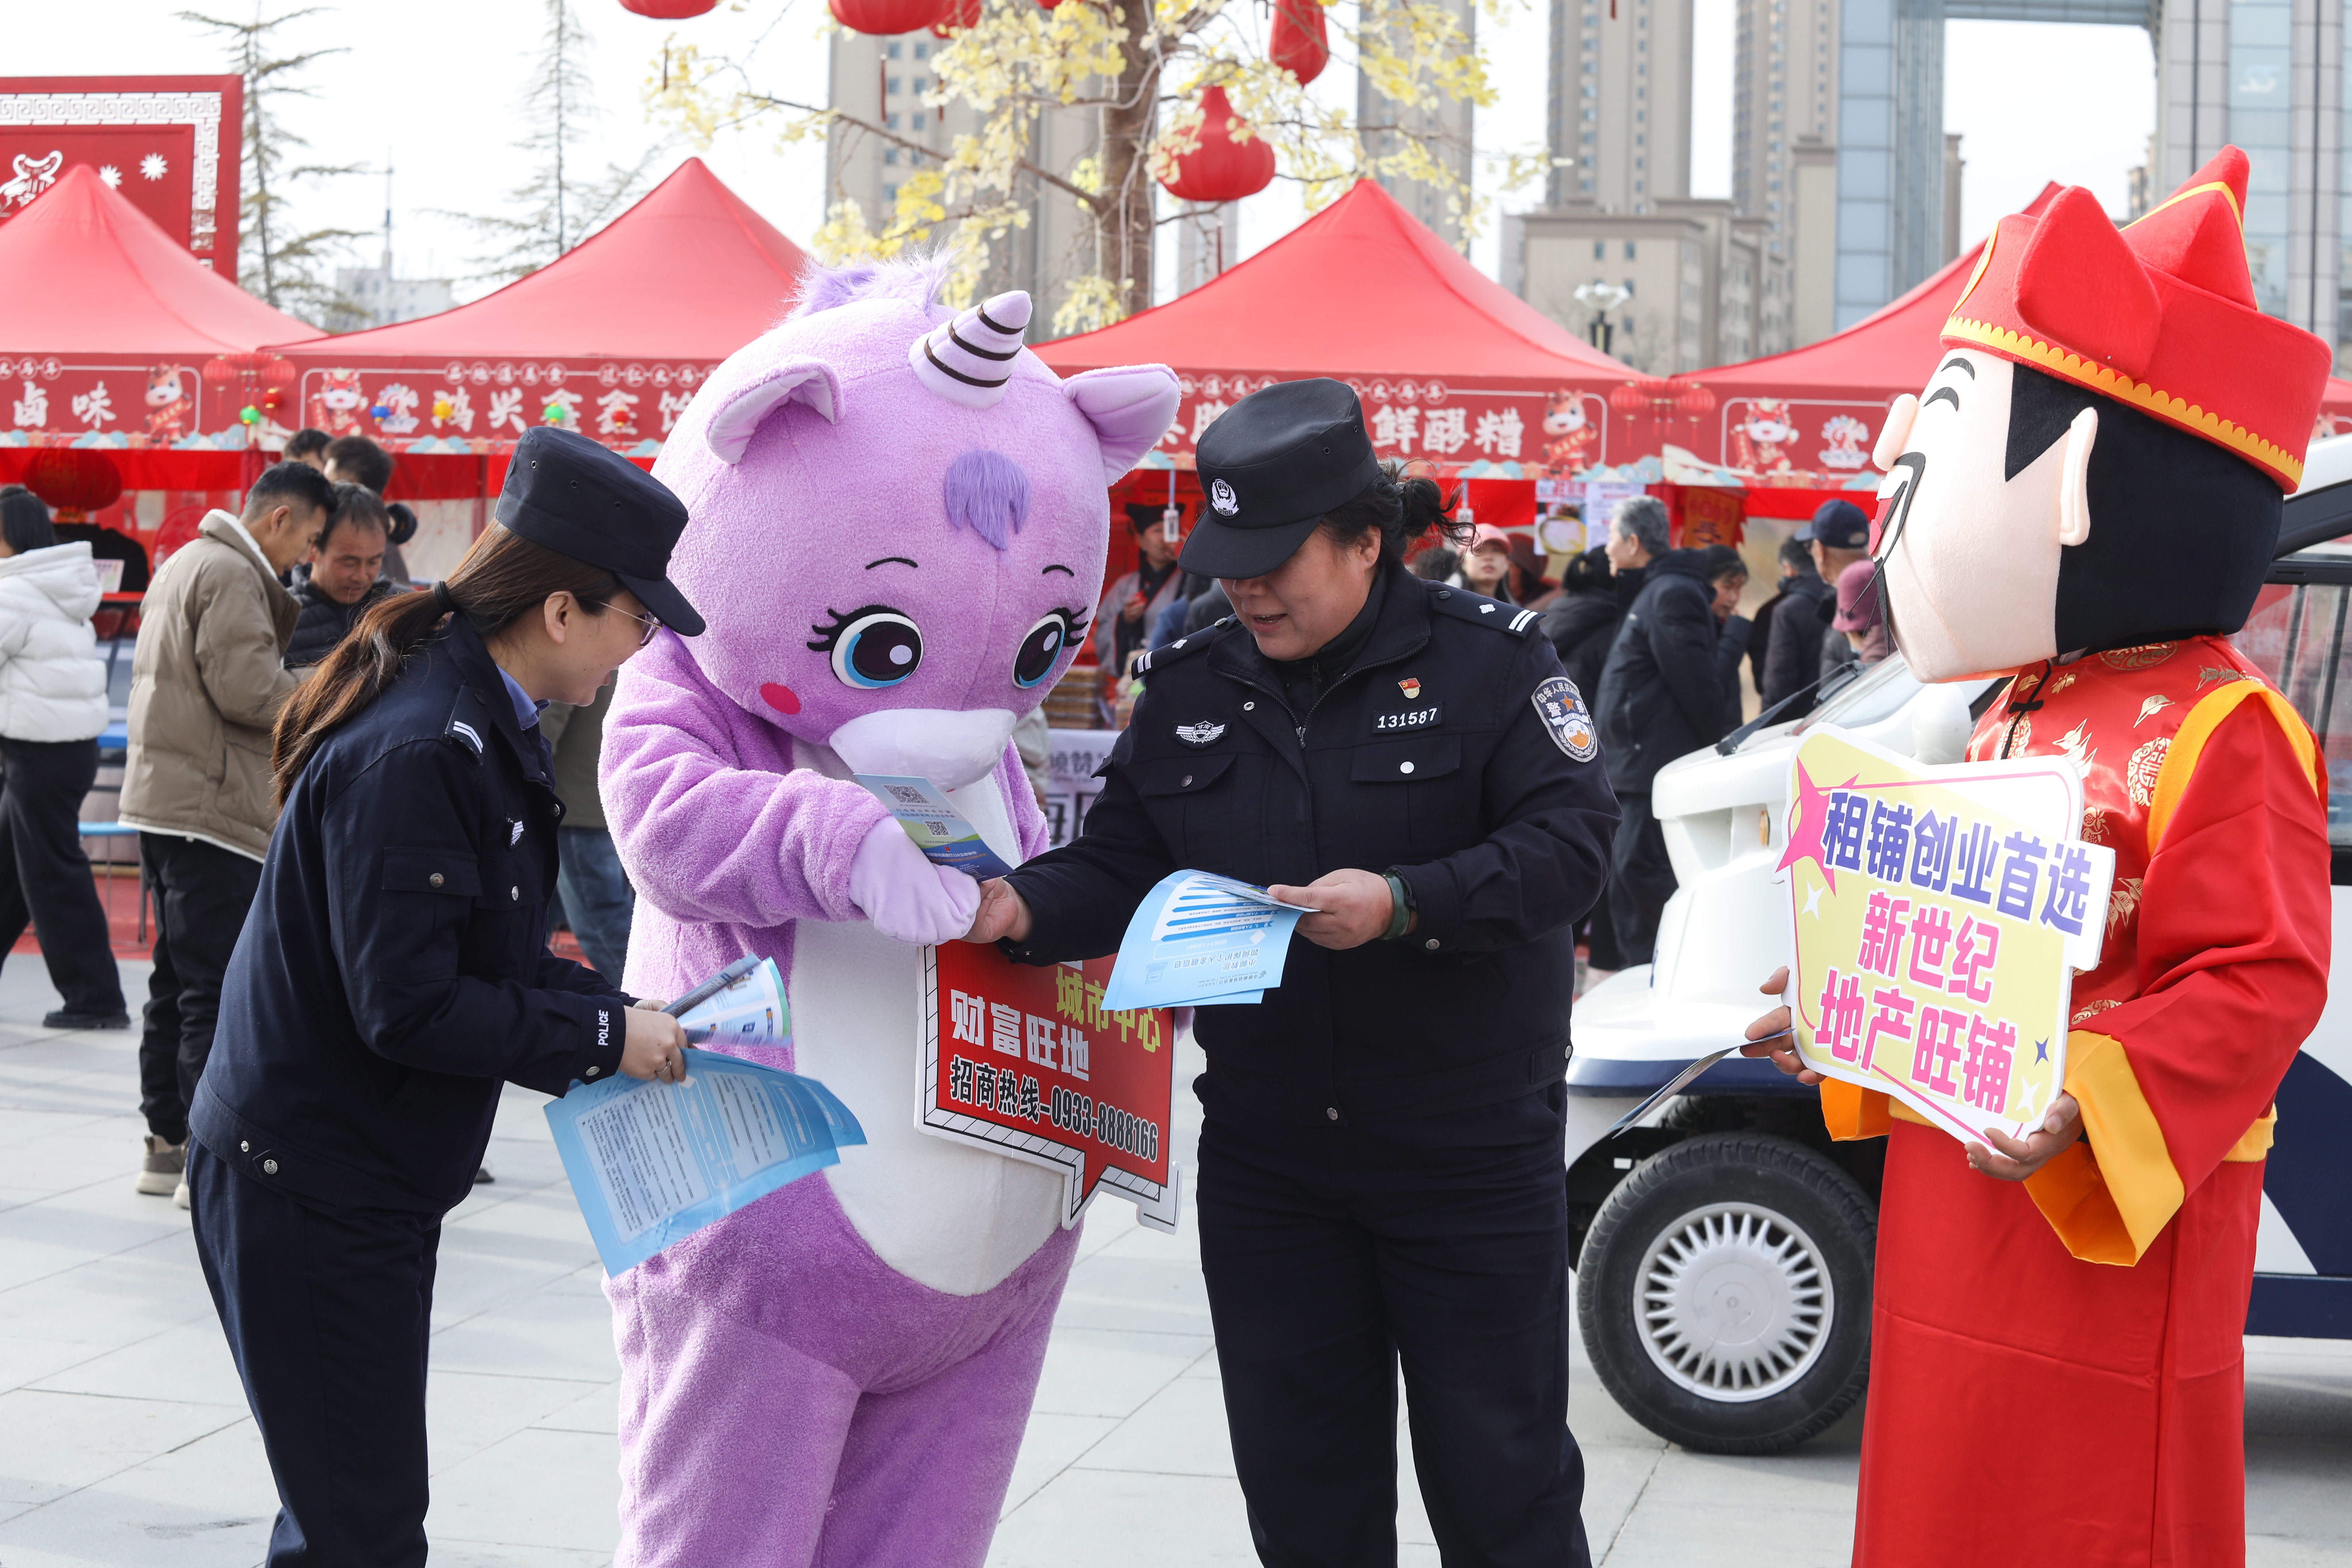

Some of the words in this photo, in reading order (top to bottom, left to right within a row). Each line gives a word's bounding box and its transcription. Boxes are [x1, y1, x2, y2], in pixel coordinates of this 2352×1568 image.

[13, 380, 117, 429] 卤味
[1377, 708, 1437, 728] 131587
[1546, 700, 1585, 717] 警察
[1563, 713, 1582, 722] POLICE
[1568, 724, 1585, 733] 公安
[1823, 791, 2091, 936] 租铺创业首选
[1174, 948, 1259, 969] 如何保护个人金融信息
[1858, 892, 1999, 1003] 新世纪
[1222, 958, 1257, 971] 小邮教您
[598, 1009, 609, 1046] POLICE
[951, 989, 1089, 1081] 财富旺地
[1814, 971, 2016, 1114] 地产旺铺
